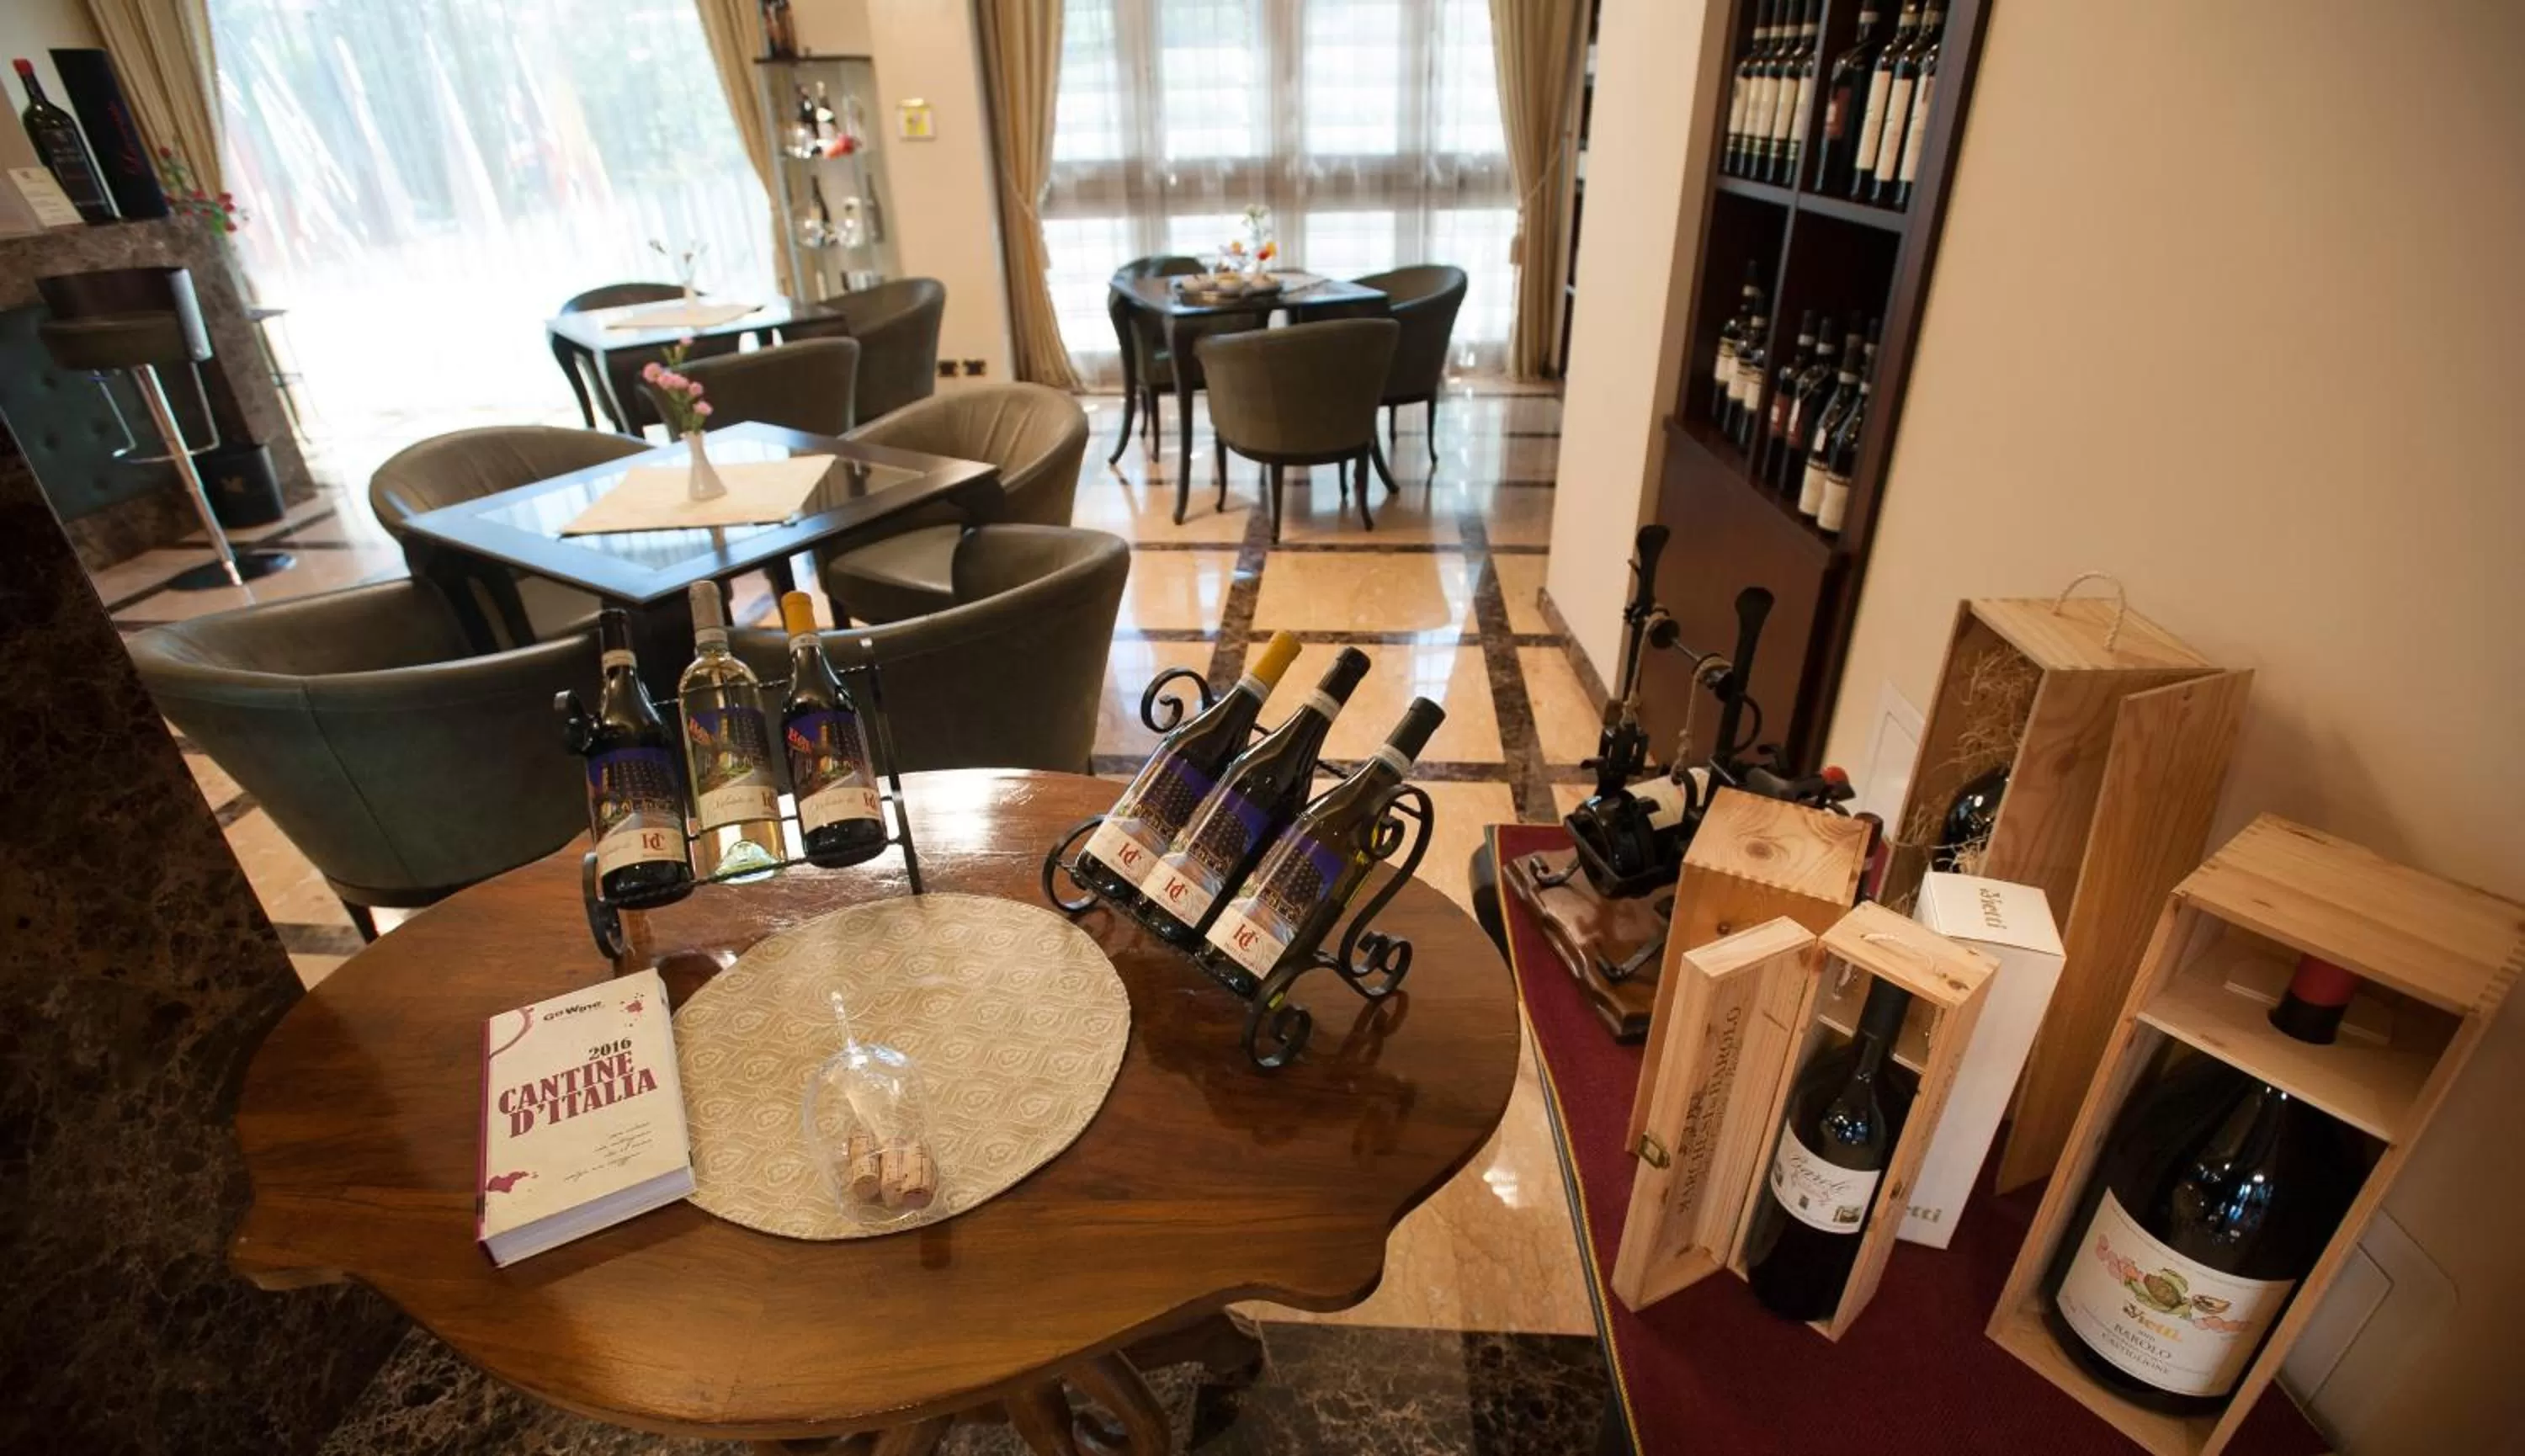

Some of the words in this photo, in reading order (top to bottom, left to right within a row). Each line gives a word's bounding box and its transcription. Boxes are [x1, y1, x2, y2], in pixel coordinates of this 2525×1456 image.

[588, 1037, 632, 1061] 2016
[498, 1050, 634, 1115] CANTINE
[509, 1067, 658, 1138] D'ITALIA
